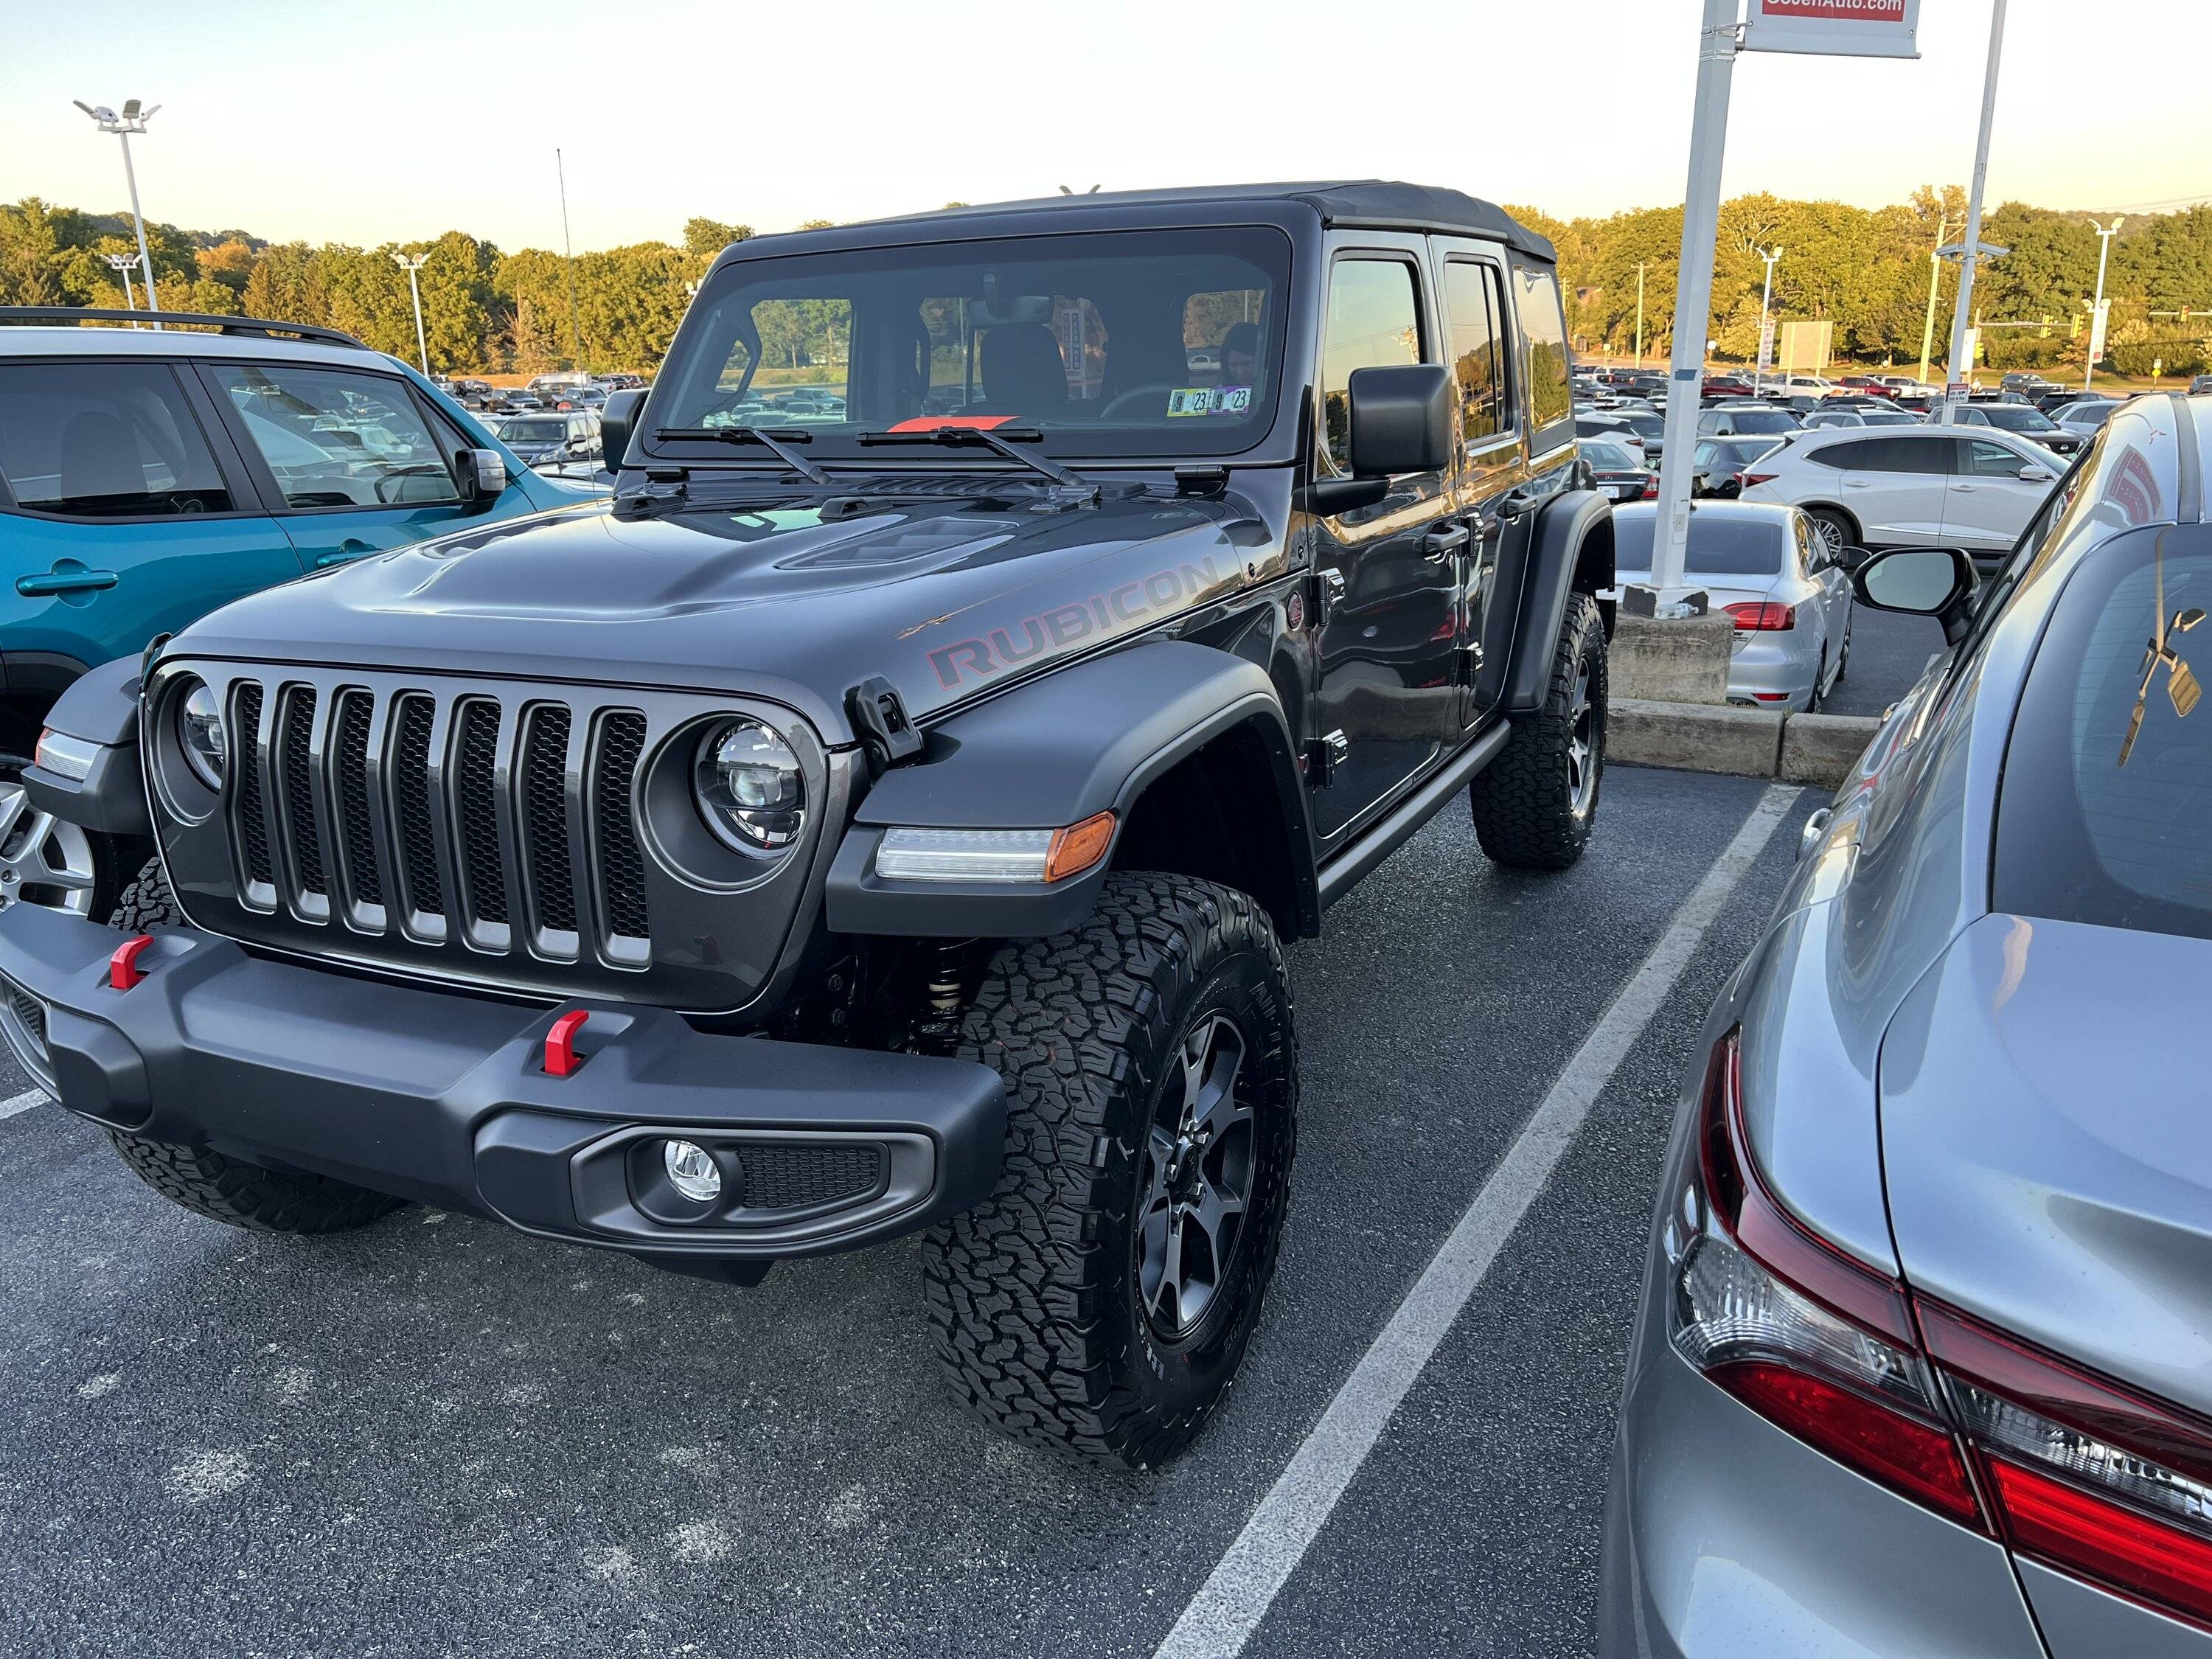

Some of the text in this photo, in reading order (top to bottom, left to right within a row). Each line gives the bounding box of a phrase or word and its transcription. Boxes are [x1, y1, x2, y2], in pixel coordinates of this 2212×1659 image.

[1175, 392, 1206, 413] 9 23
[1215, 390, 1246, 410] 9 23
[926, 556, 1220, 691] RUBICON
